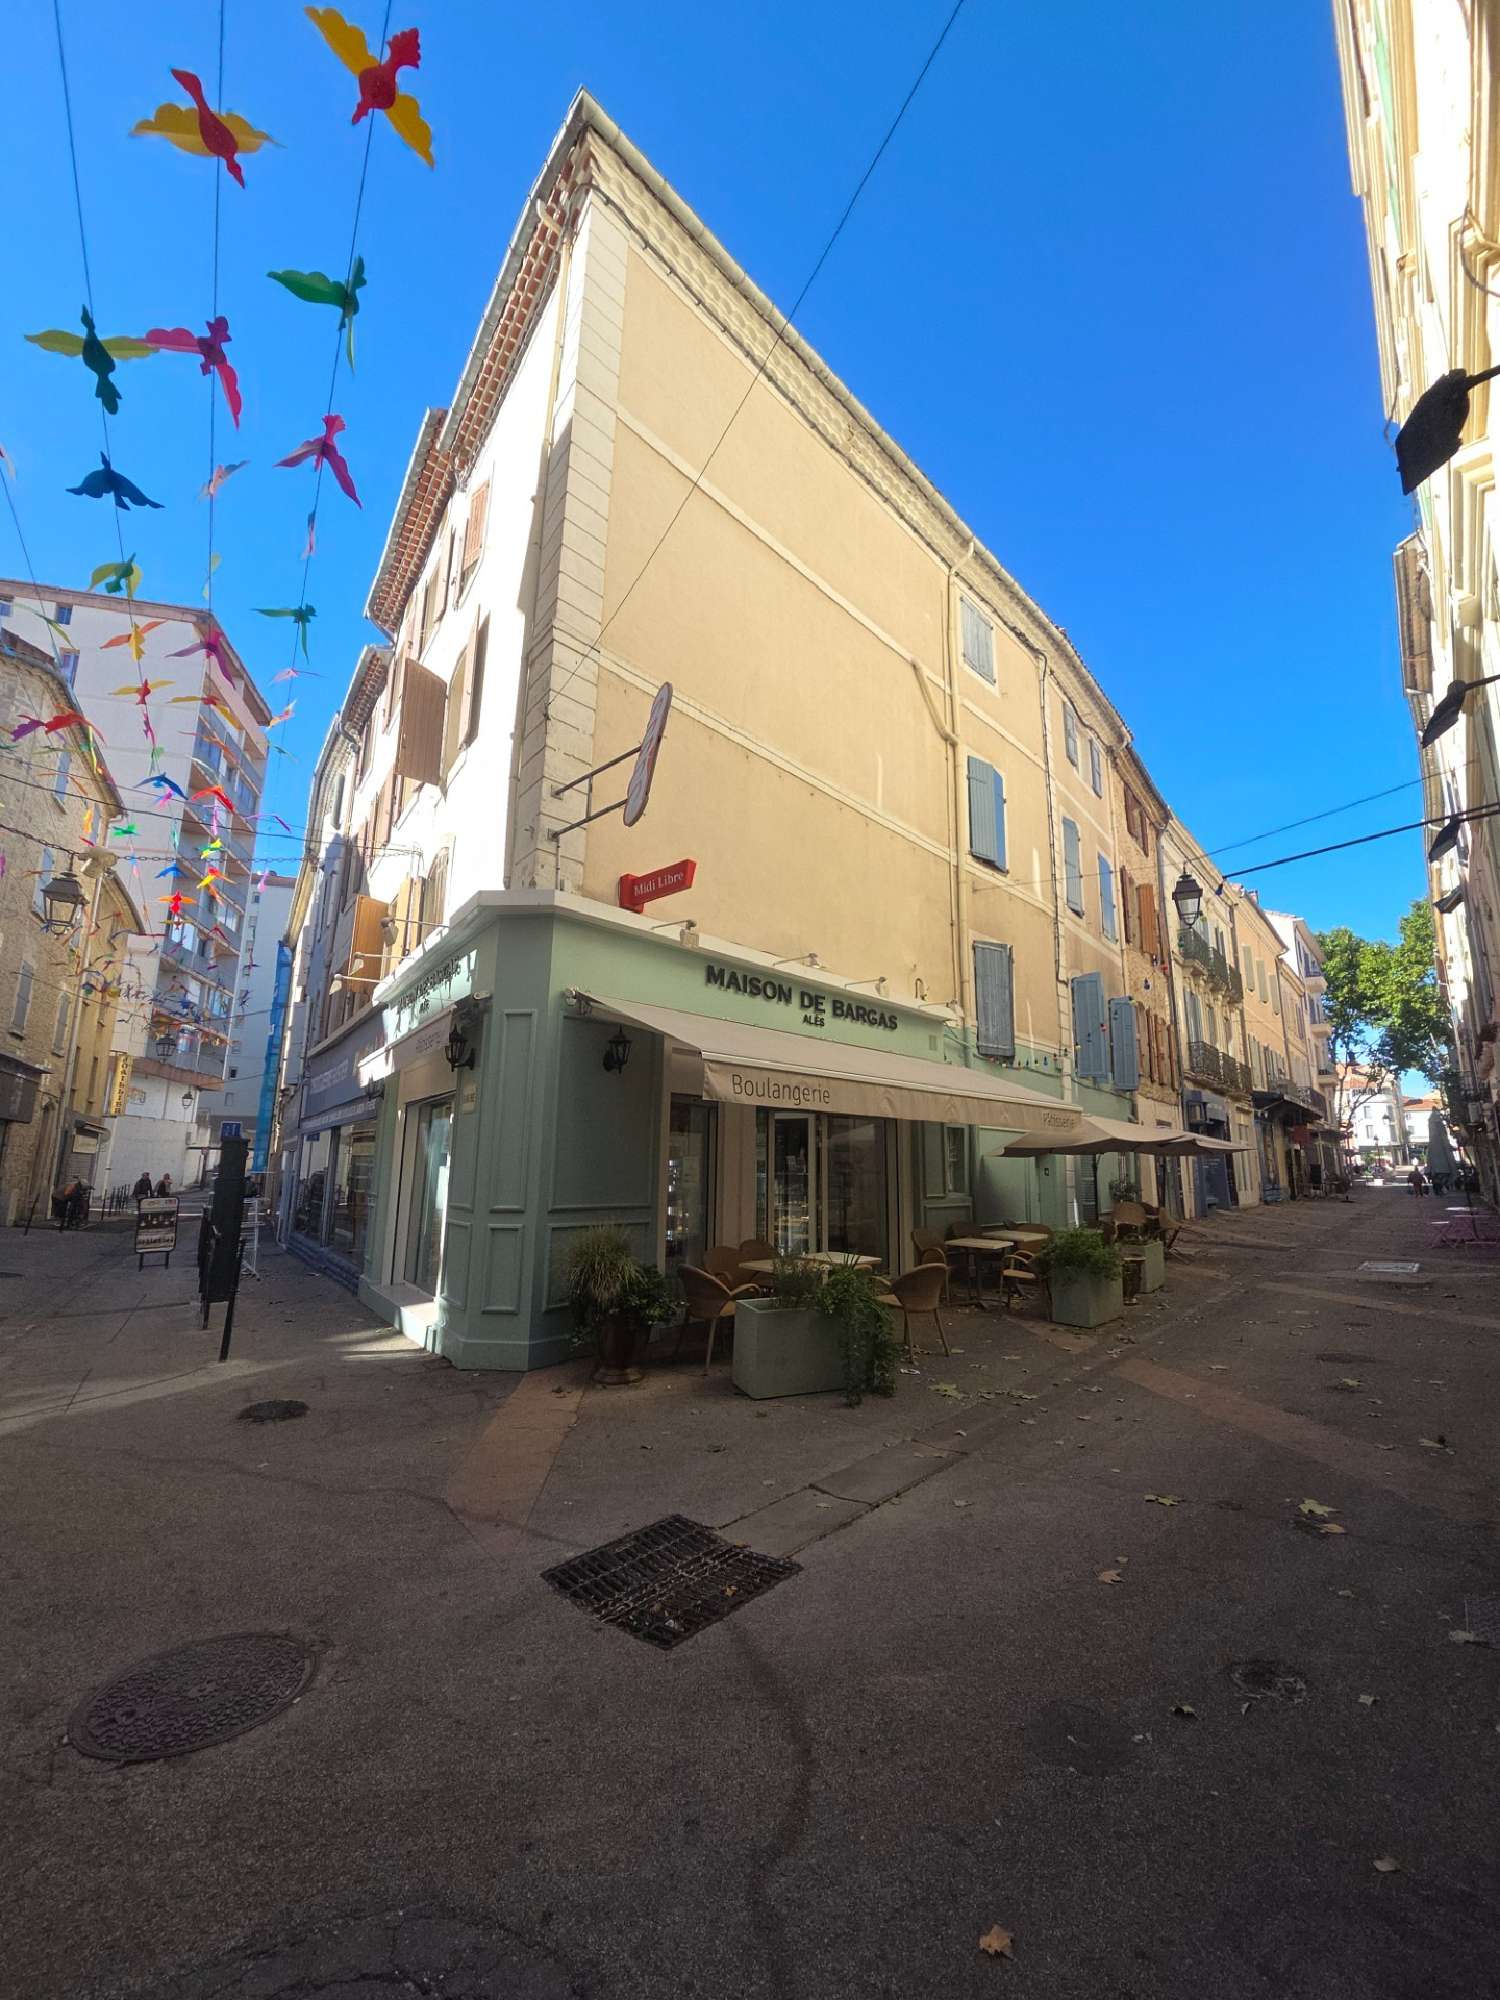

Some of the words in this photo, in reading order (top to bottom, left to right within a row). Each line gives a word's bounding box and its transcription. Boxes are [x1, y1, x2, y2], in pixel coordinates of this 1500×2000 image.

[633, 879, 656, 897] Midi
[657, 871, 684, 889] Libre
[705, 965, 793, 1004] MAISON
[800, 990, 826, 1014] DE
[831, 999, 899, 1030] BARGAS
[732, 1074, 831, 1106] Boulangerie
